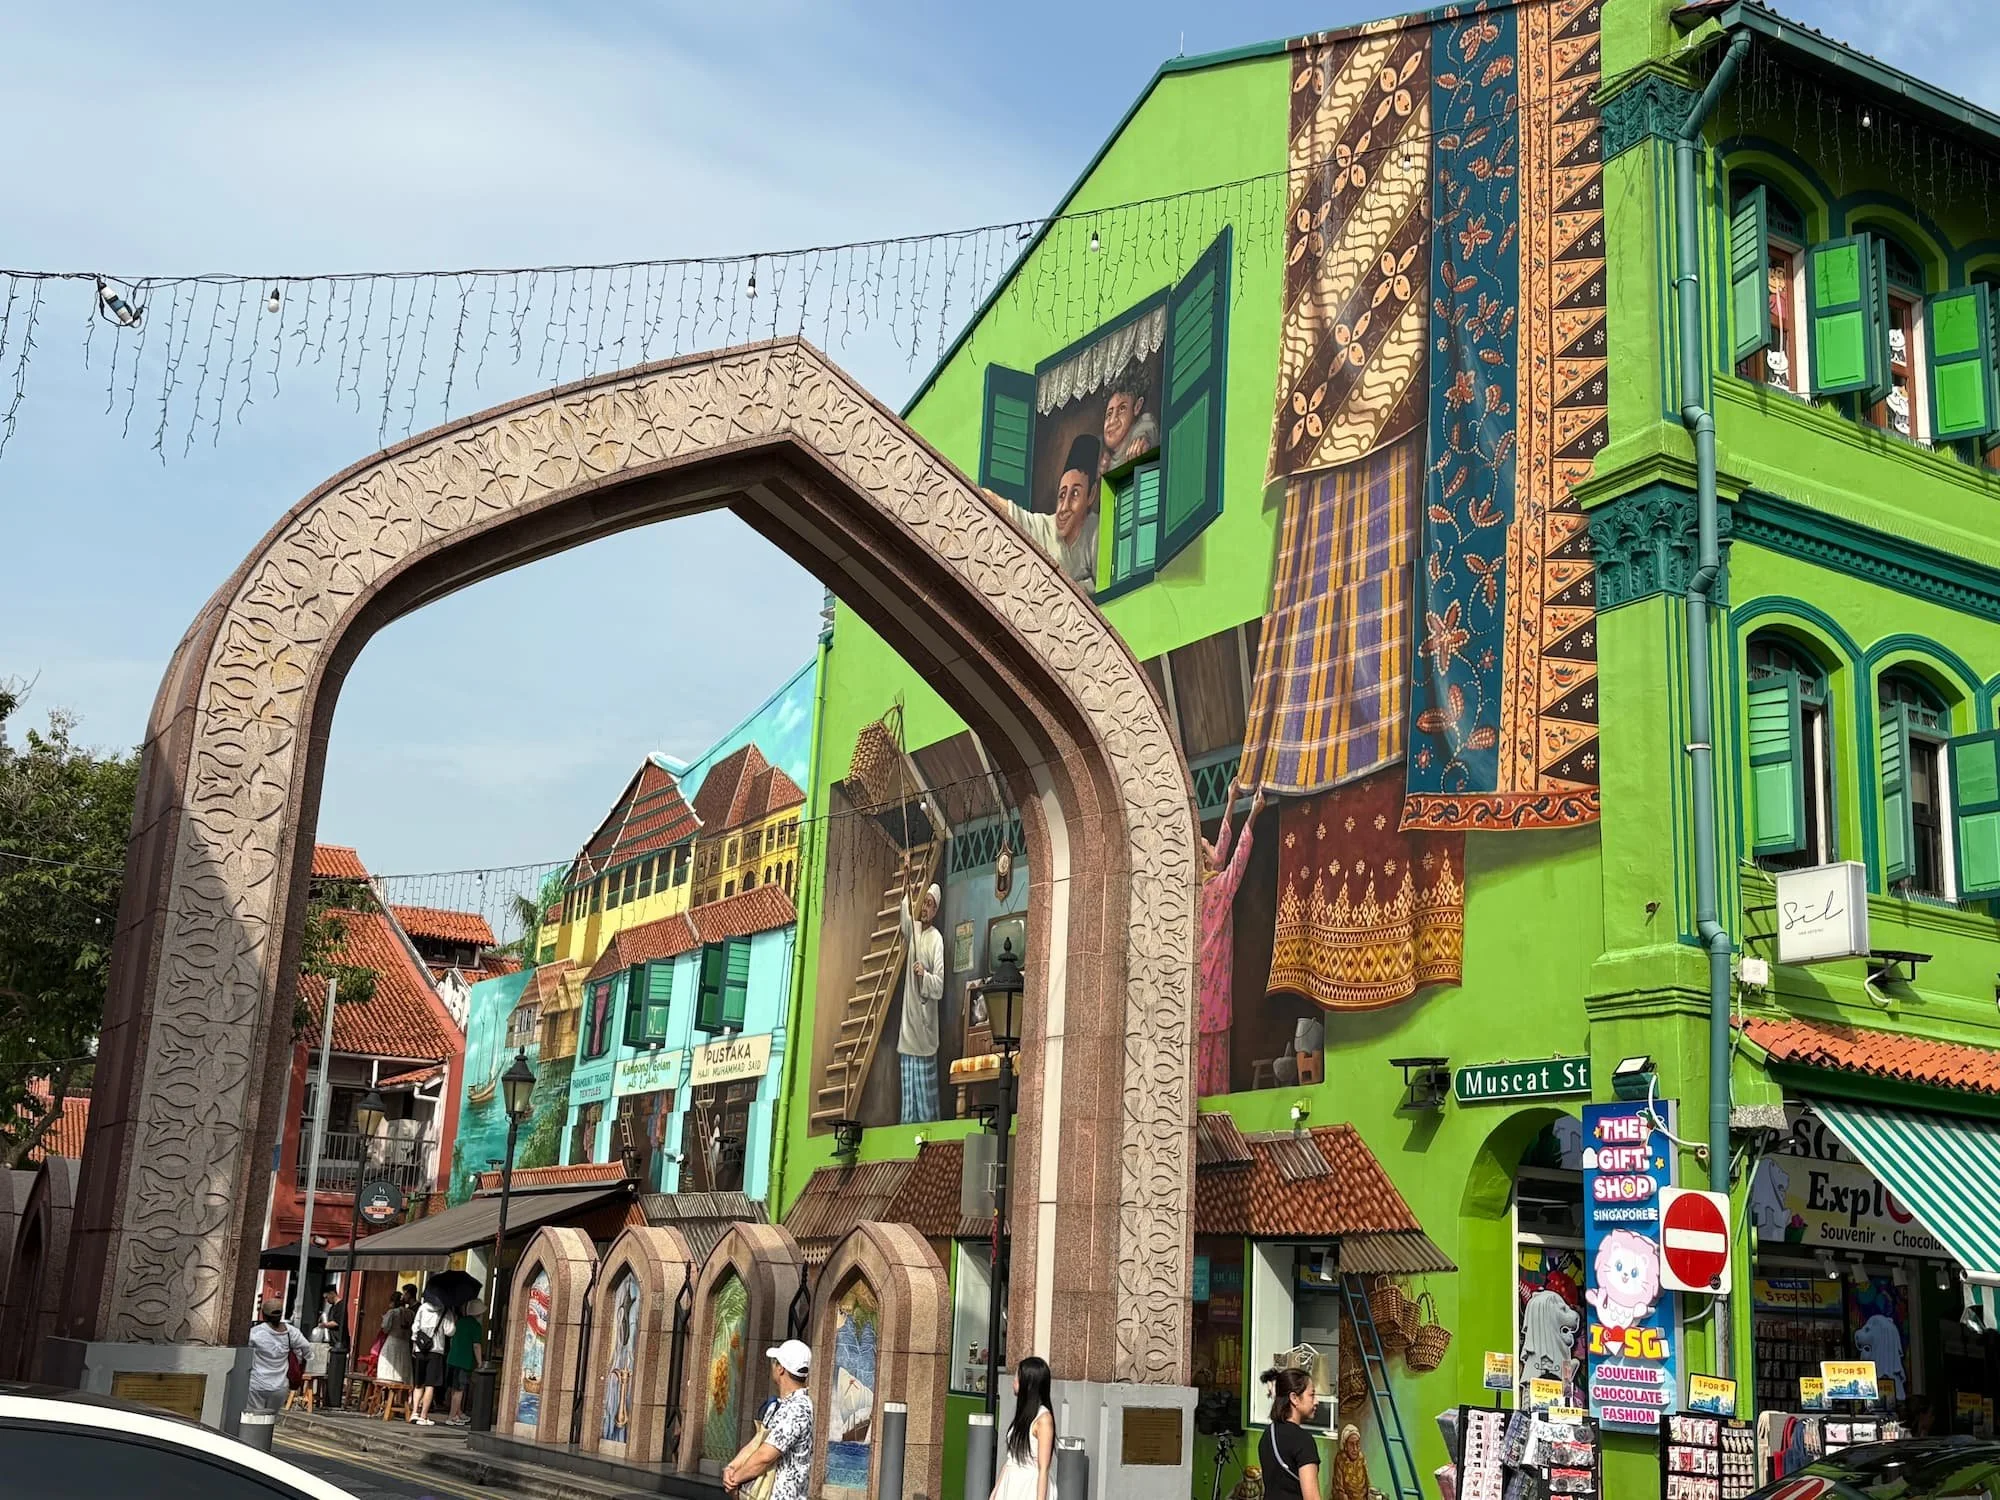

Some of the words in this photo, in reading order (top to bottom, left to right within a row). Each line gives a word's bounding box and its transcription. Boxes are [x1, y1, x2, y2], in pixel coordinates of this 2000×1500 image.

[706, 1043, 751, 1066] PUSTAKA
[712, 1063, 745, 1077] MUHAMMAD
[1465, 1067, 1549, 1095] Muscat
[1563, 1063, 1587, 1088] St
[1599, 1117, 1641, 1140] THE
[1598, 1148, 1645, 1171] GIFT
[1594, 1177, 1649, 1199] SHOP
[1593, 1208, 1648, 1221] SINGAPORE
[1820, 1222, 1875, 1244] Souvenir
[1893, 1229, 1947, 1252] Chocola
[1589, 1325, 1603, 1354] I
[1624, 1328, 1661, 1359] SG
[1597, 1366, 1657, 1382] SOUVENIR
[1856, 1367, 1866, 1375] $1
[1592, 1386, 1663, 1404] CHOCOLATE
[1704, 1382, 1719, 1390] FOR
[1720, 1384, 1730, 1392] $1
[1602, 1407, 1655, 1423] FASHION
